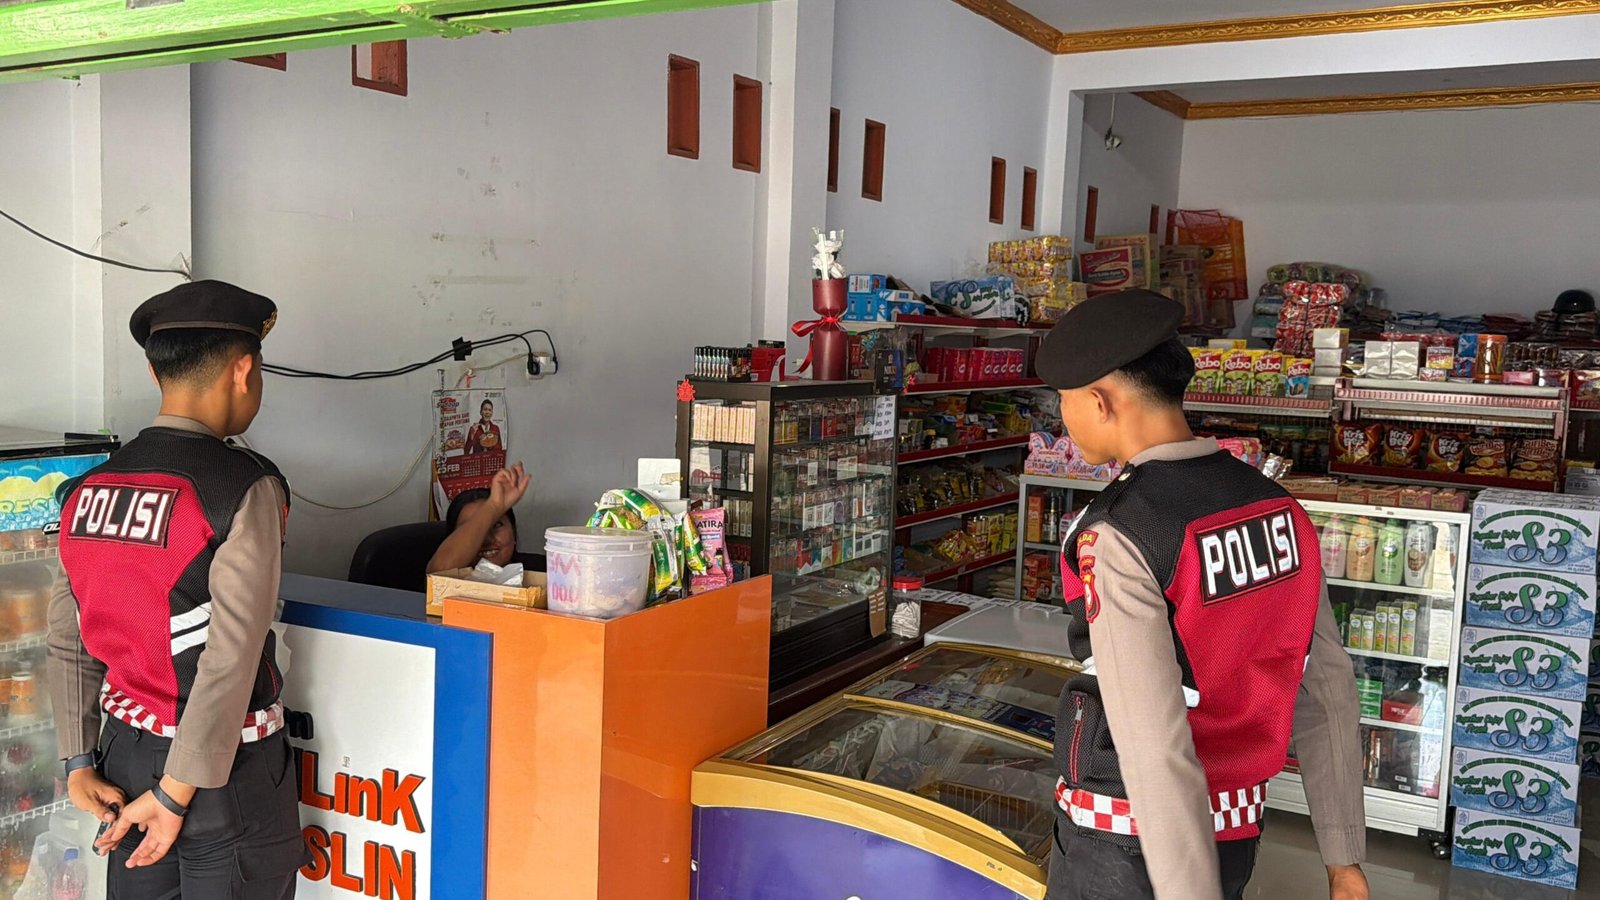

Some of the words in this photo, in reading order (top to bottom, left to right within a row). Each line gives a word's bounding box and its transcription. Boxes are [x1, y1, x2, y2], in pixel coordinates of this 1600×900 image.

[1195, 357, 1220, 370] Rebo
[1224, 358, 1251, 371] Rebo
[1255, 358, 1280, 371] Rebo
[1287, 364, 1310, 376] Rebo
[1344, 429, 1364, 439] Kris
[1389, 430, 1412, 440] Kris
[1344, 438, 1364, 446] Bee
[1389, 438, 1409, 447] Bee
[1438, 438, 1459, 447] Kris
[1439, 445, 1459, 455] Bee
[448, 464, 460, 472] FEB
[70, 487, 170, 542] POLISI
[696, 520, 724, 529] ATIRA
[1079, 533, 1093, 544] LDA
[1508, 521, 1572, 565] S3
[1201, 511, 1299, 597] POLISI
[1504, 583, 1568, 627] S3
[1498, 646, 1561, 690] S3
[1490, 708, 1553, 752] S3
[1488, 769, 1550, 813] S3
[1489, 832, 1552, 876] S3
